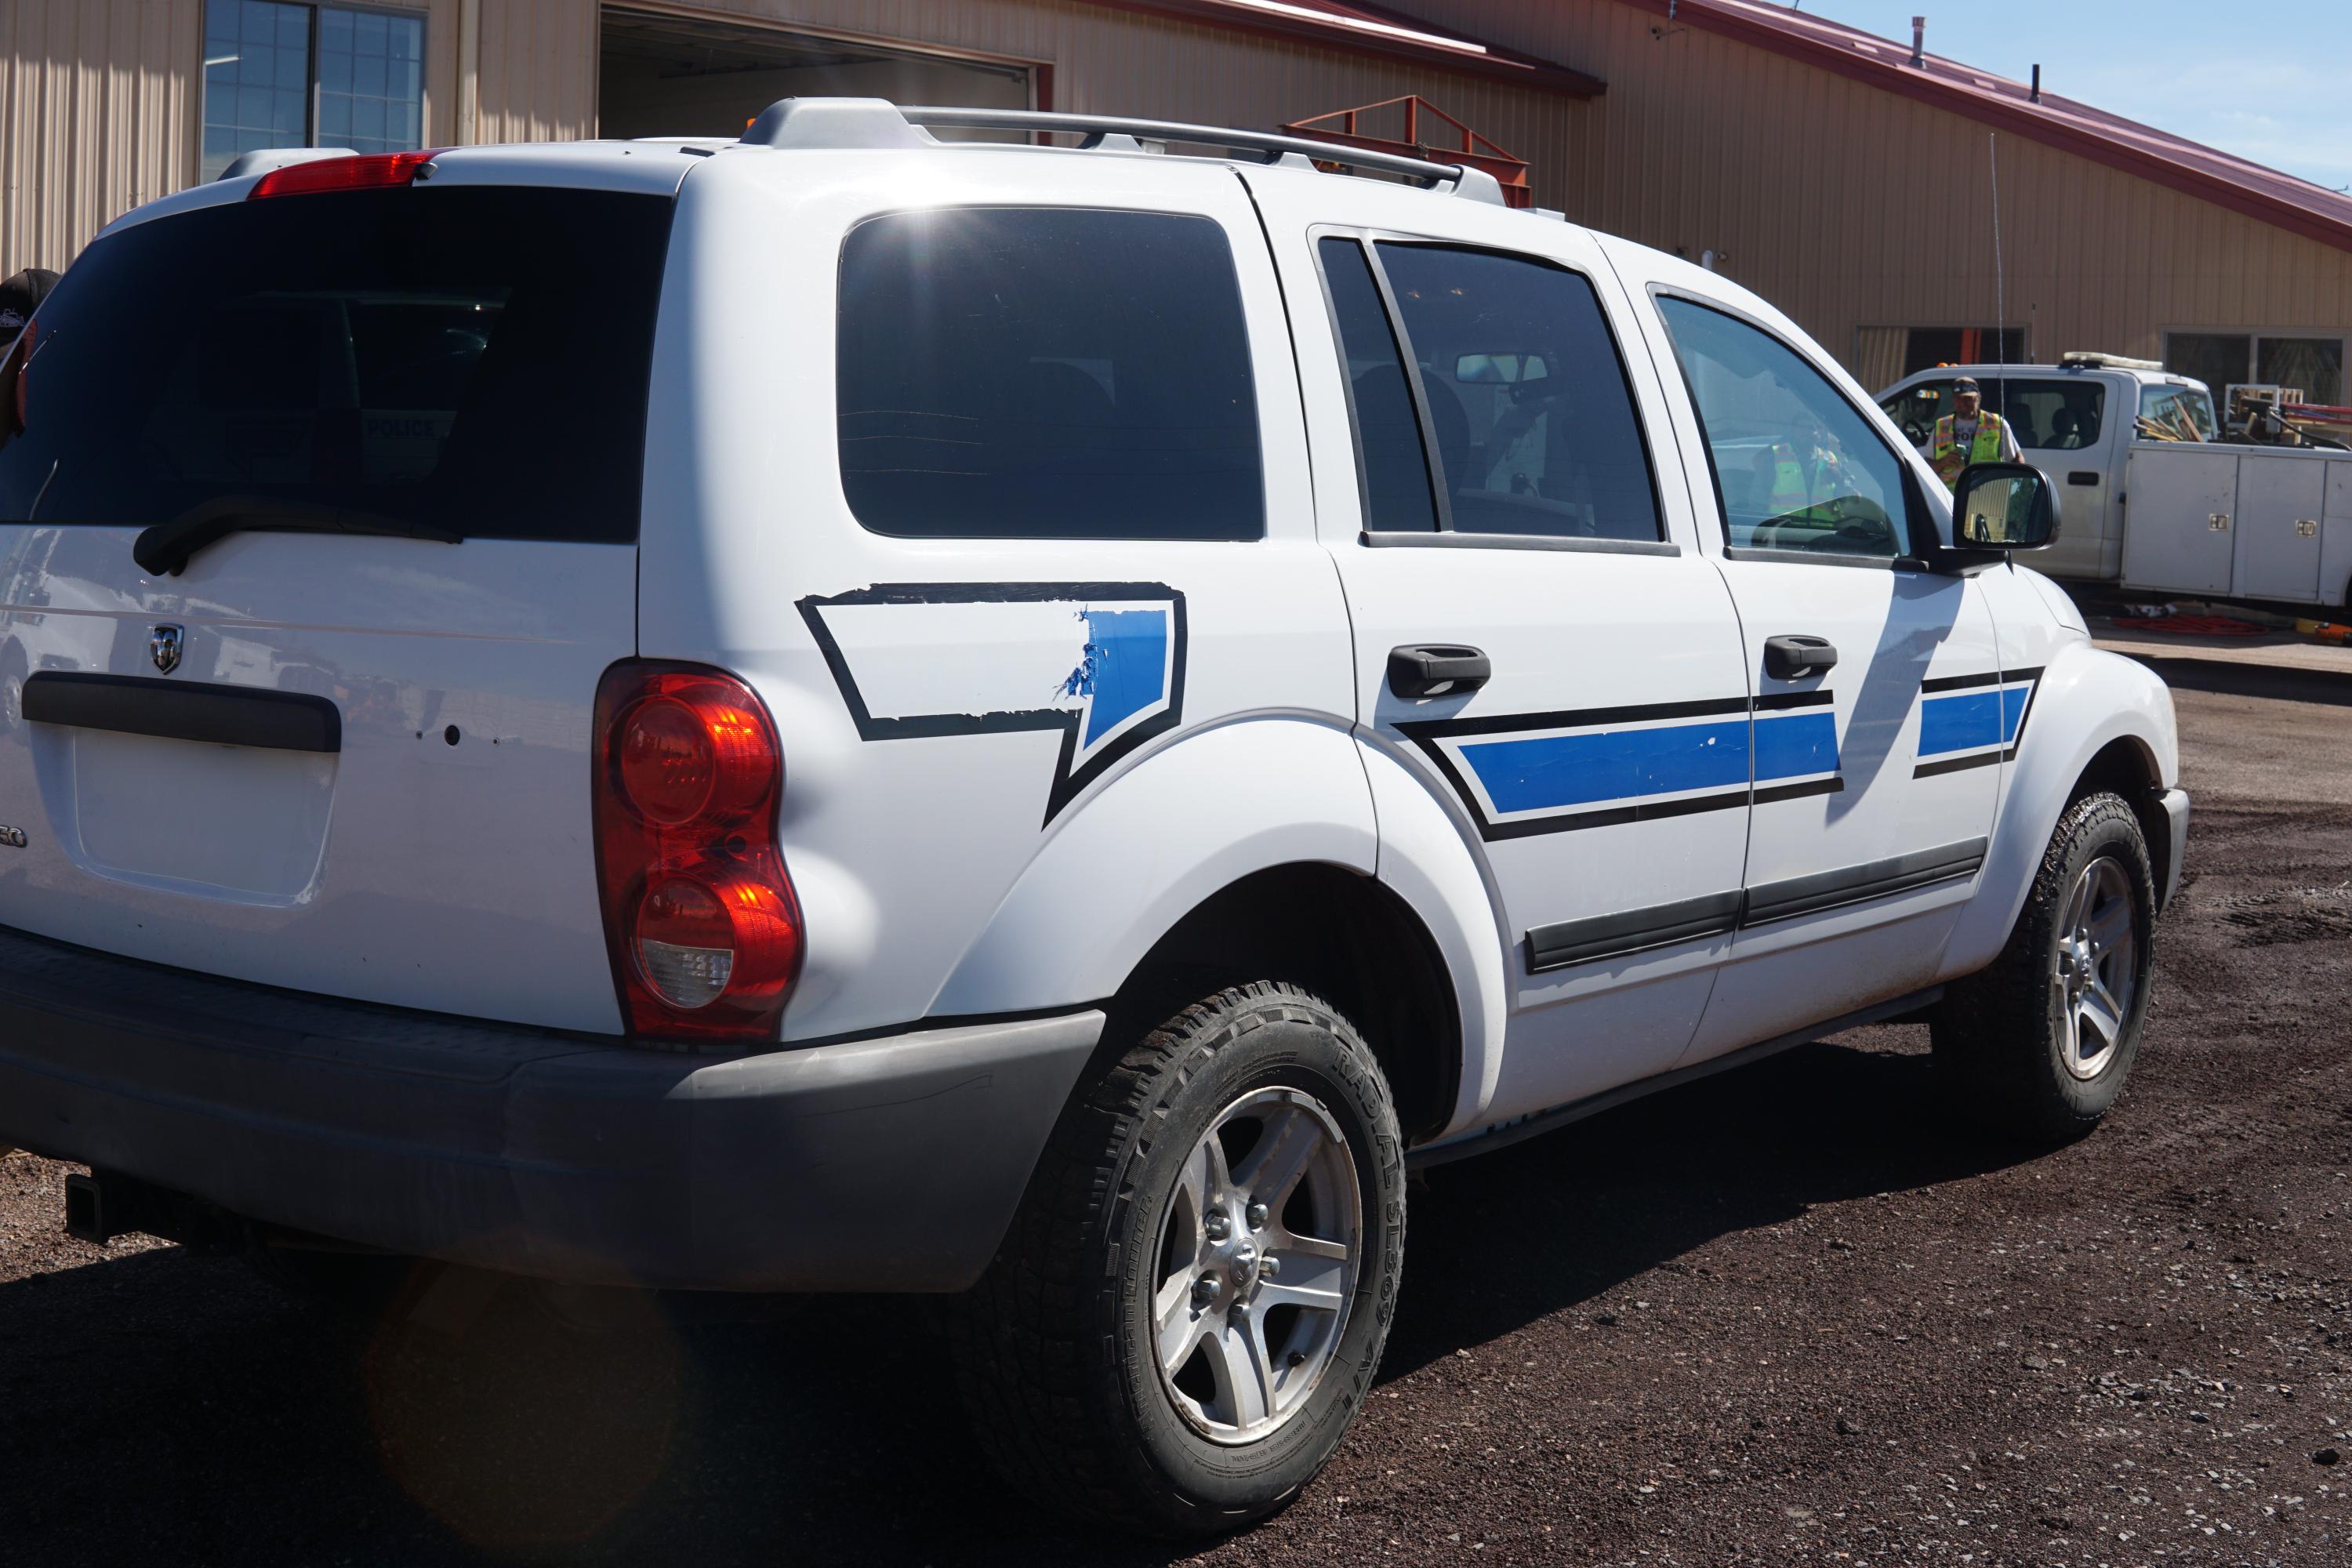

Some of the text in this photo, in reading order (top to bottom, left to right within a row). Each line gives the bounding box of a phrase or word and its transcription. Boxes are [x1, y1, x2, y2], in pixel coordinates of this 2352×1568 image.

[368, 420, 434, 438] POLICE
[1332, 1047, 1398, 1189] RADIAL
[1375, 1201, 1401, 1327] SL369
